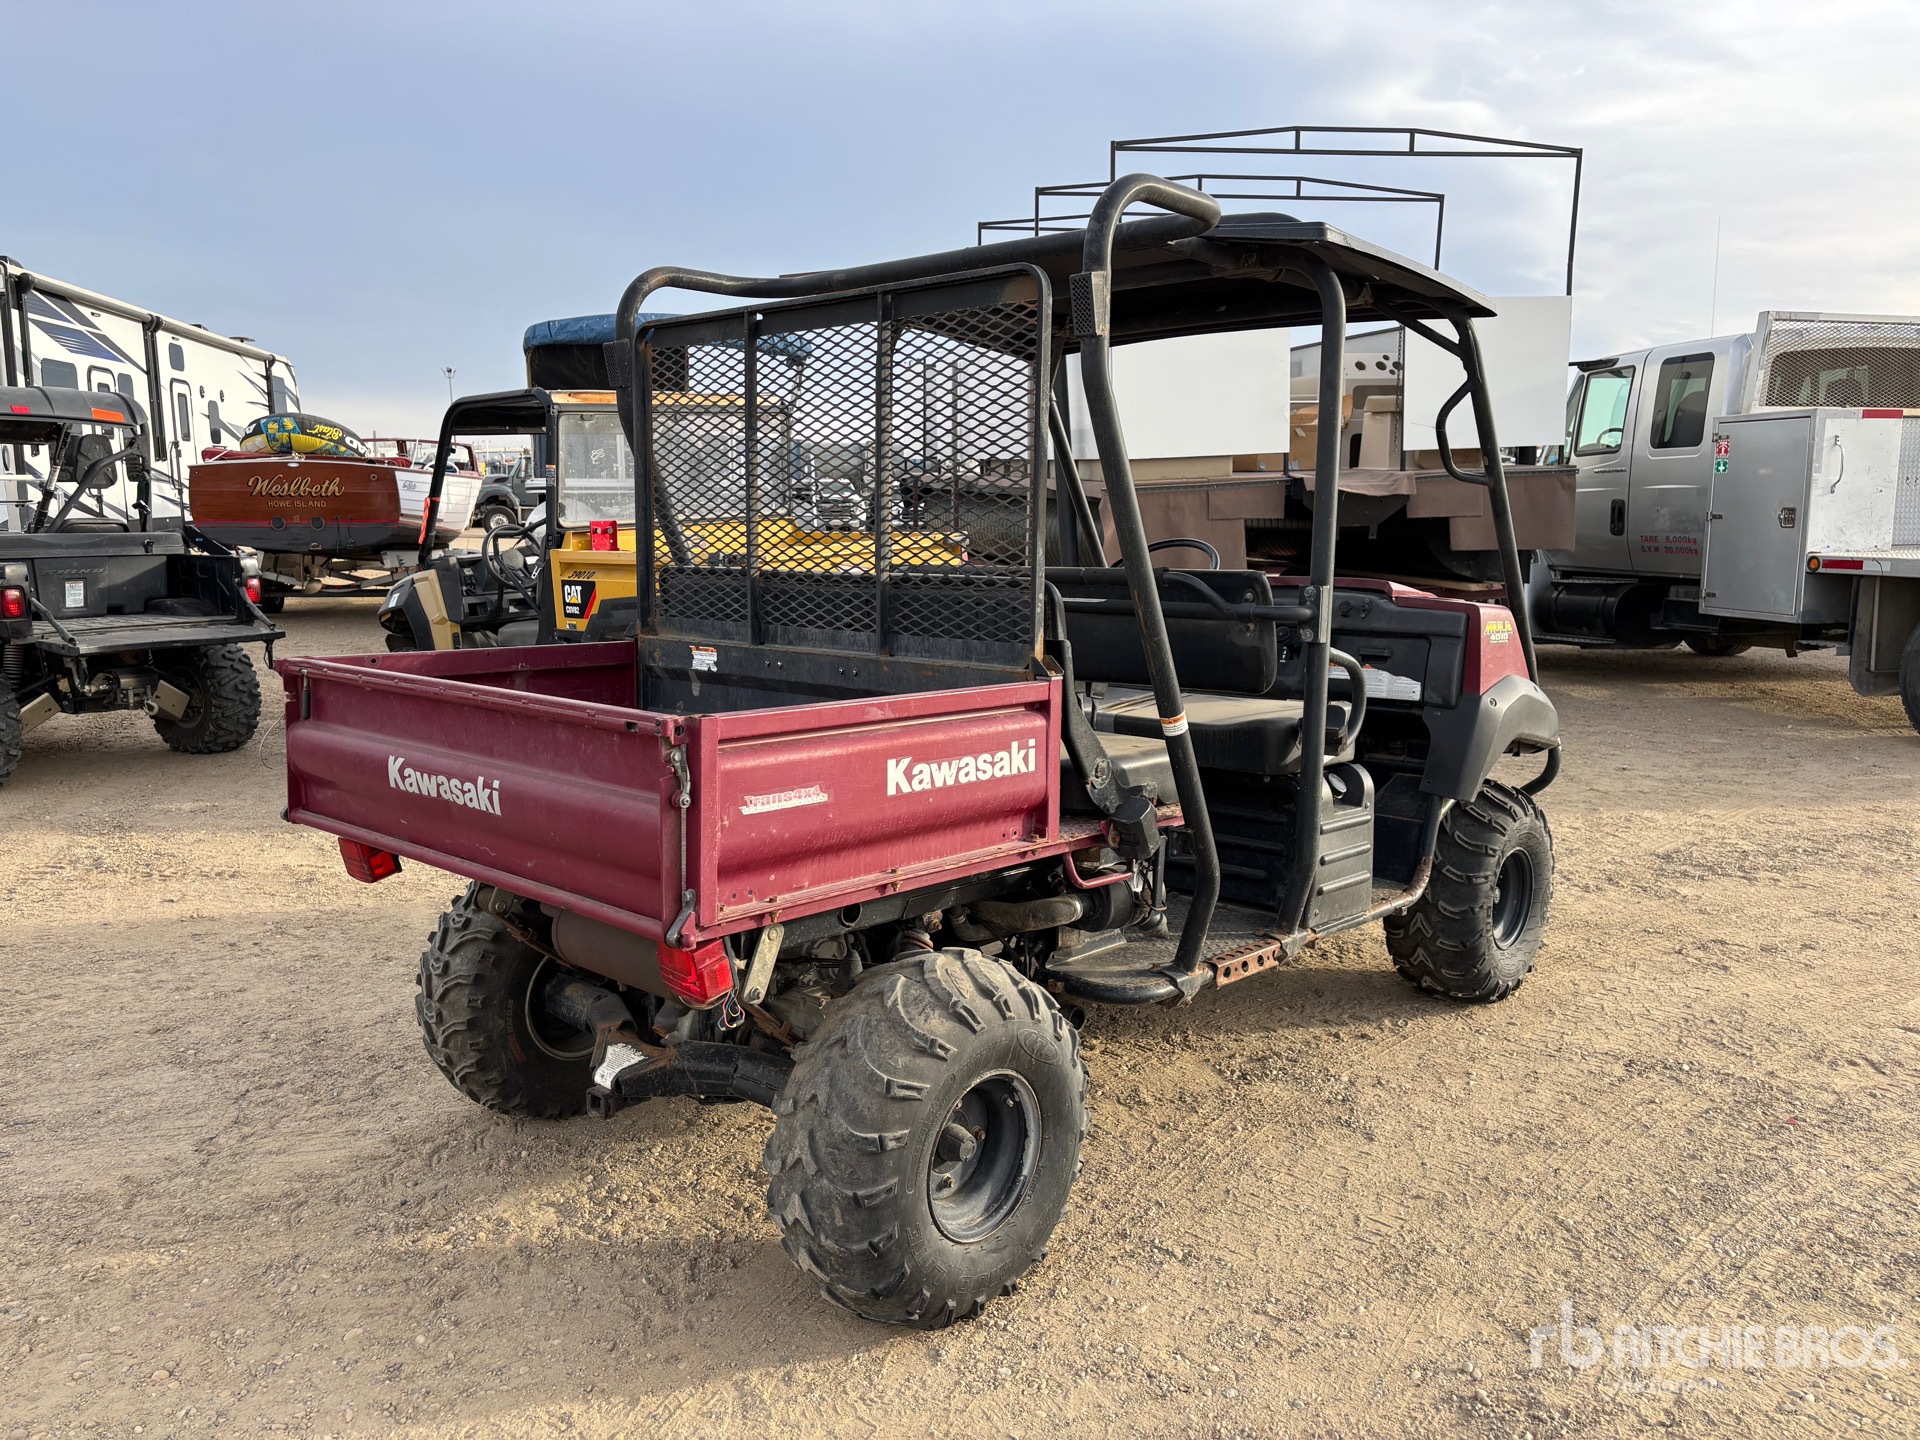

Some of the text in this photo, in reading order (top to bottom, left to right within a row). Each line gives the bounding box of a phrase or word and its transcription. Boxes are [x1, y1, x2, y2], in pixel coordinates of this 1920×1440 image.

[306, 424, 342, 440] Blast
[268, 500, 327, 508] HOWE ISLAND
[1640, 535, 1697, 545] TARE 5,000kg
[1664, 546, 1699, 556] 20,000kg
[567, 570, 597, 580] 39010
[564, 584, 582, 604] CAT
[1484, 620, 1514, 636] MULE
[886, 738, 1036, 797] Kawasaki
[387, 754, 502, 816] Kawasaki
